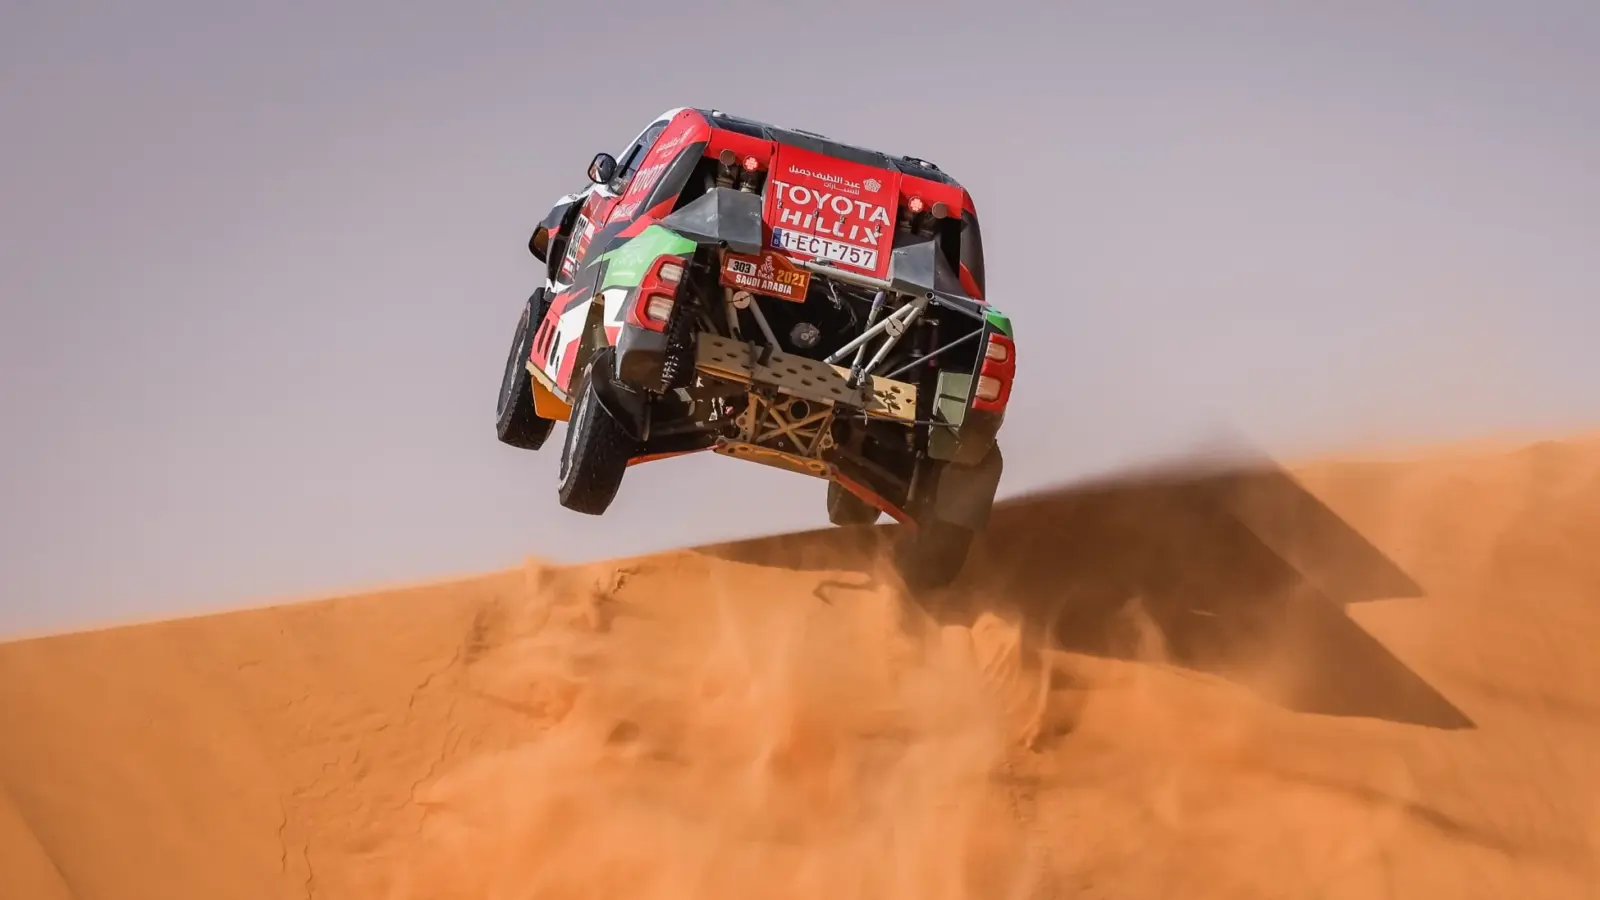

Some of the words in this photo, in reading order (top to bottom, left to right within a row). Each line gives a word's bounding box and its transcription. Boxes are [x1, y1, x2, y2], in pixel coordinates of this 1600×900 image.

[788, 164, 811, 177] جميل
[812, 171, 843, 184] اللطيف
[844, 180, 861, 189] عبد
[772, 179, 891, 226] TOYOTA
[783, 231, 873, 266] 1-ECT-757
[733, 260, 752, 274] 303
[735, 273, 760, 289] SAUDI
[761, 280, 793, 295] ARABIA
[776, 269, 805, 287] 2021
